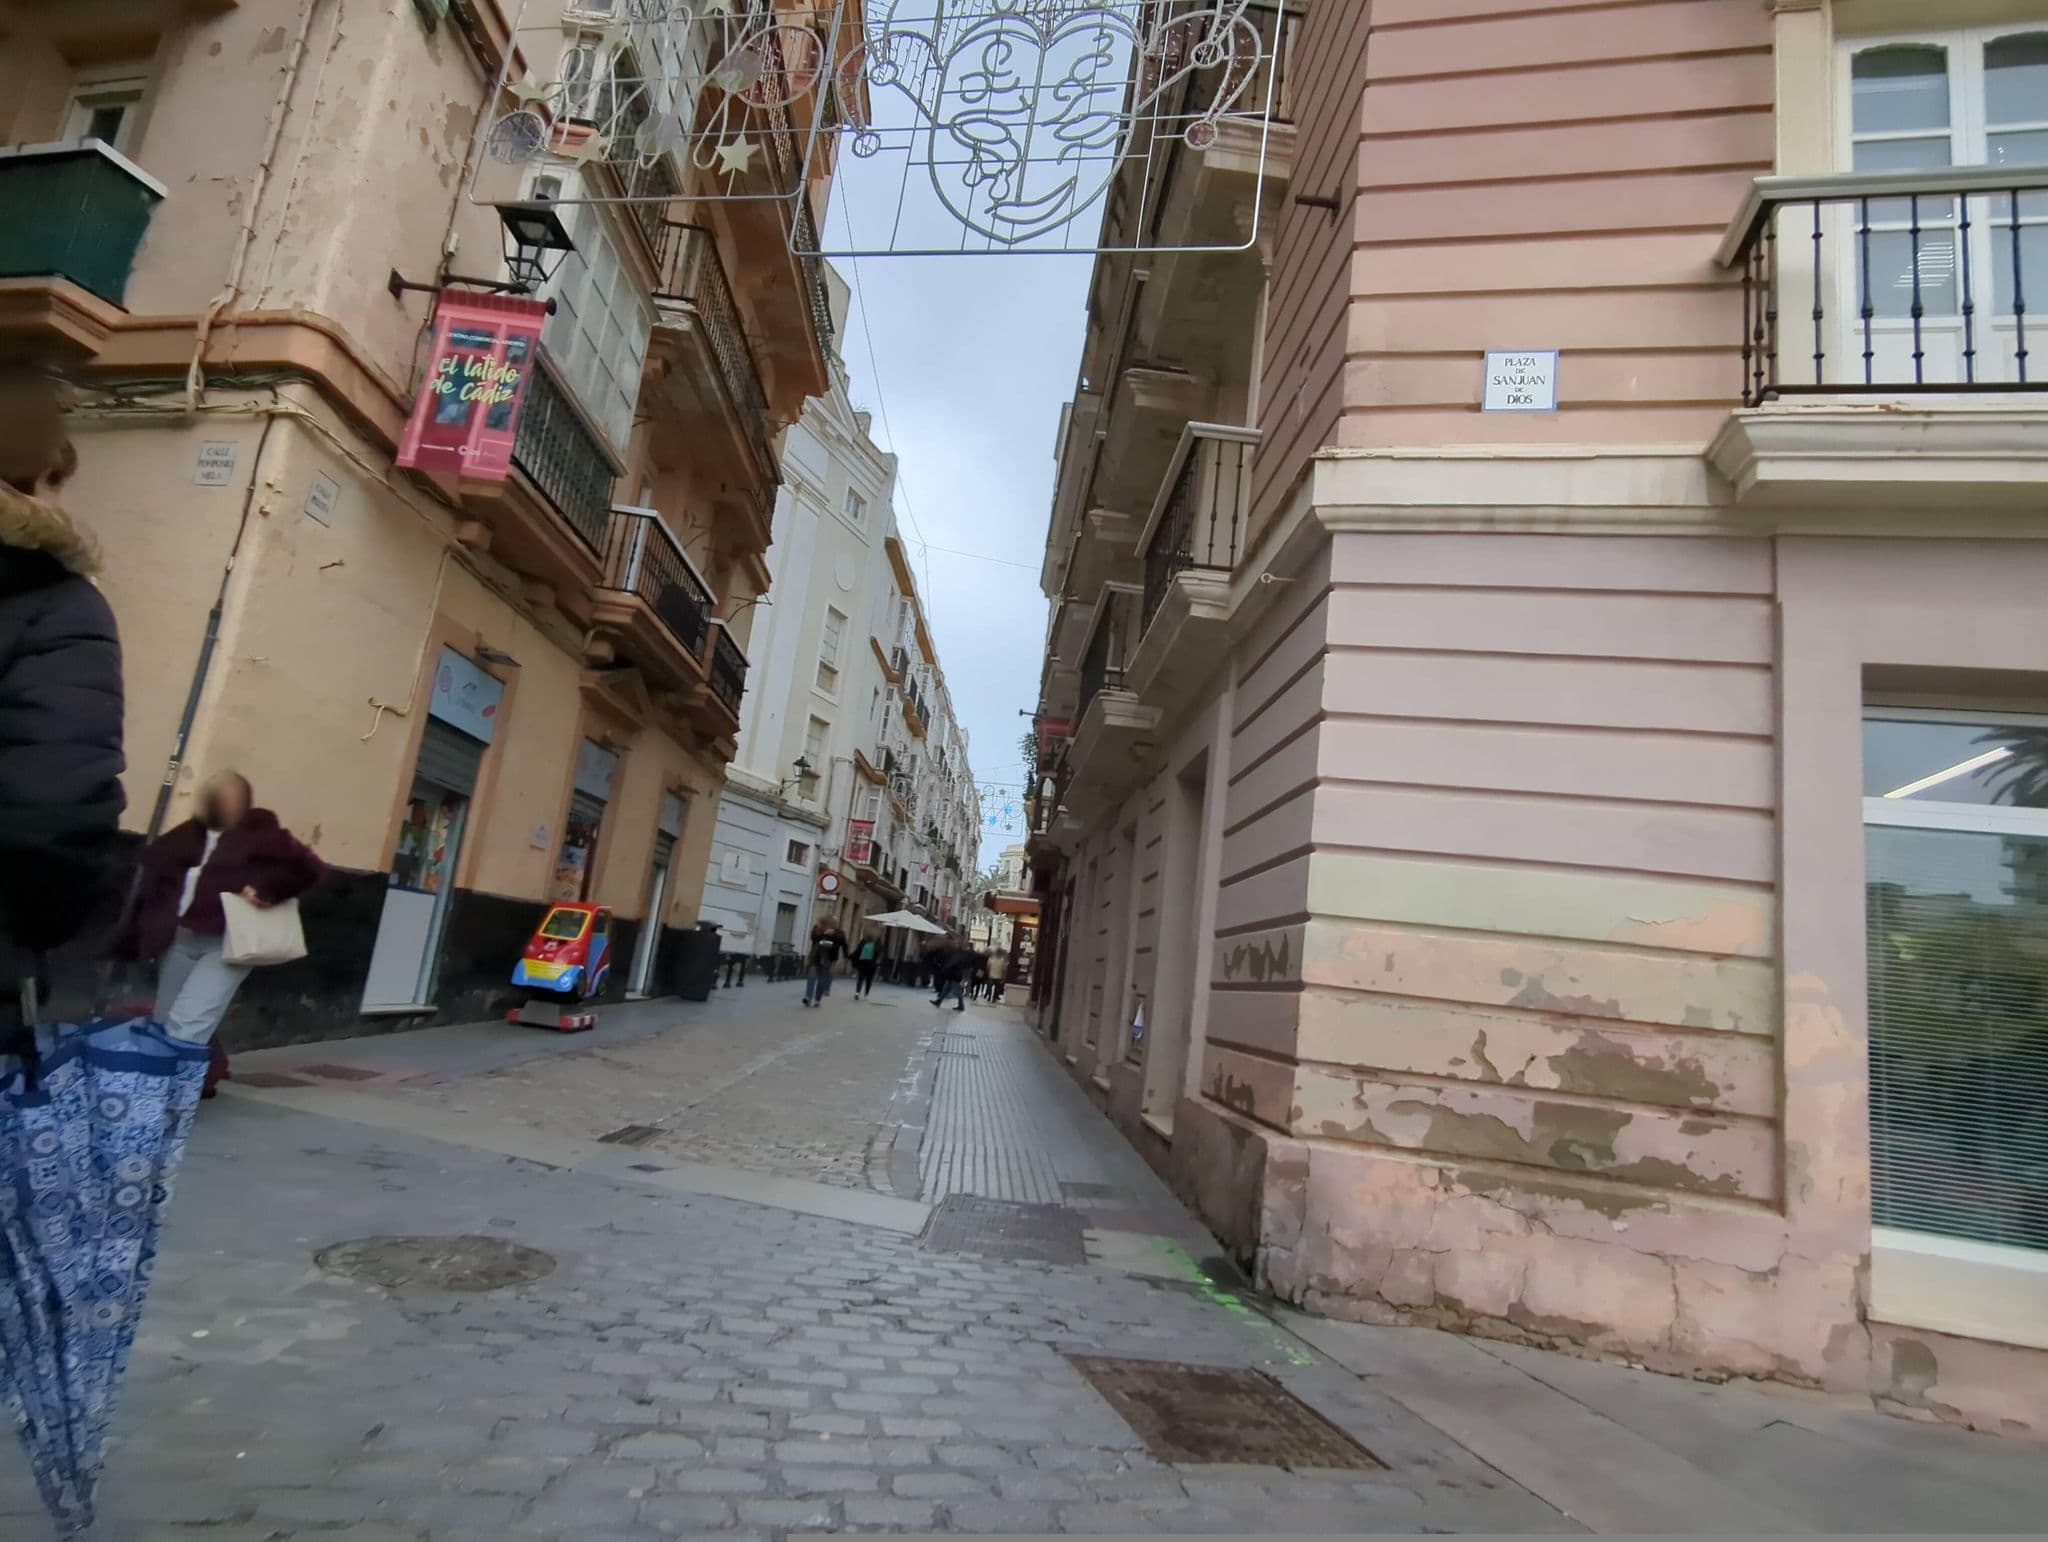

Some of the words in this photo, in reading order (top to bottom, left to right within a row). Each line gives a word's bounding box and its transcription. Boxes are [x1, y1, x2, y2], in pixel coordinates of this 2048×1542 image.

[438, 354, 459, 375] El
[464, 354, 520, 383] latido
[1504, 358, 1536, 366] PLAZA
[429, 376, 456, 394] de
[460, 381, 514, 404] Cádiz
[1507, 395, 1533, 404] DIOS
